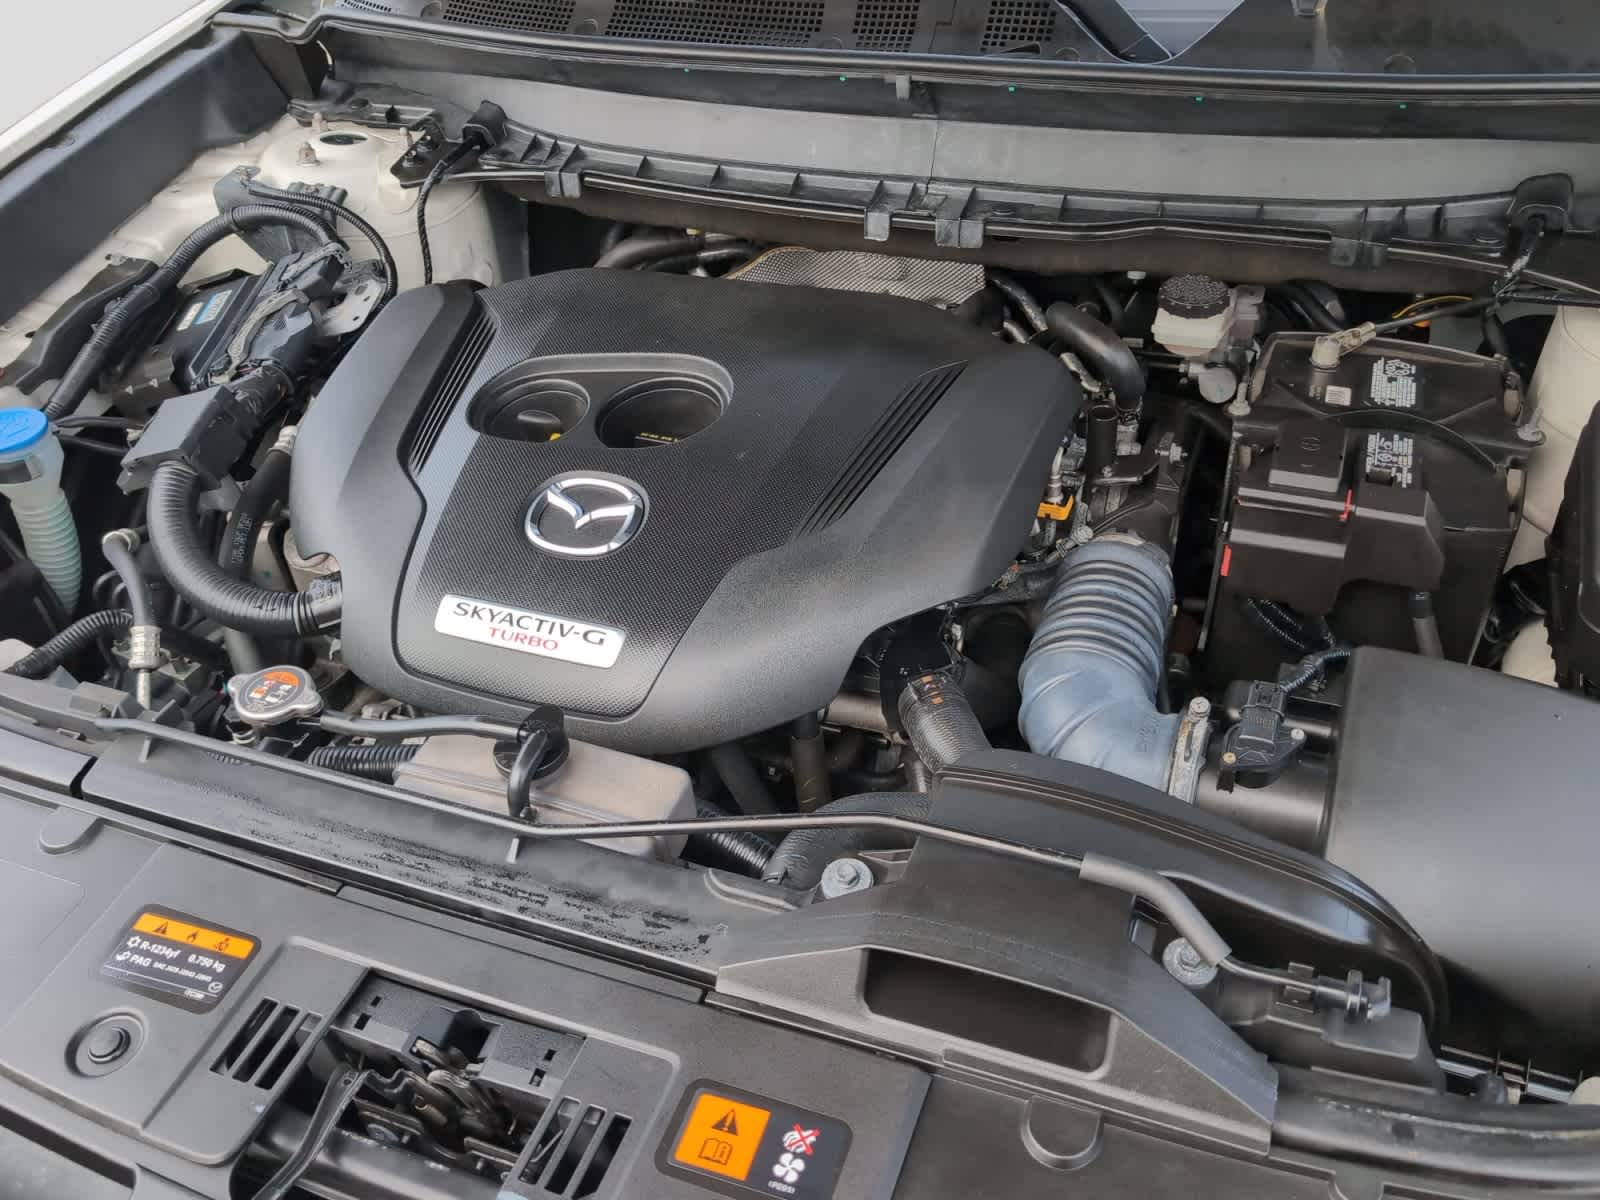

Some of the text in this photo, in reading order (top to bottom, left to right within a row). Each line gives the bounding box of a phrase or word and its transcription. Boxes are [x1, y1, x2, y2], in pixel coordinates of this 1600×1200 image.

[453, 602, 607, 646] SKYACTIV-G
[488, 627, 559, 651] TURBO
[128, 954, 152, 968] PAG
[212, 960, 226, 974] kg
